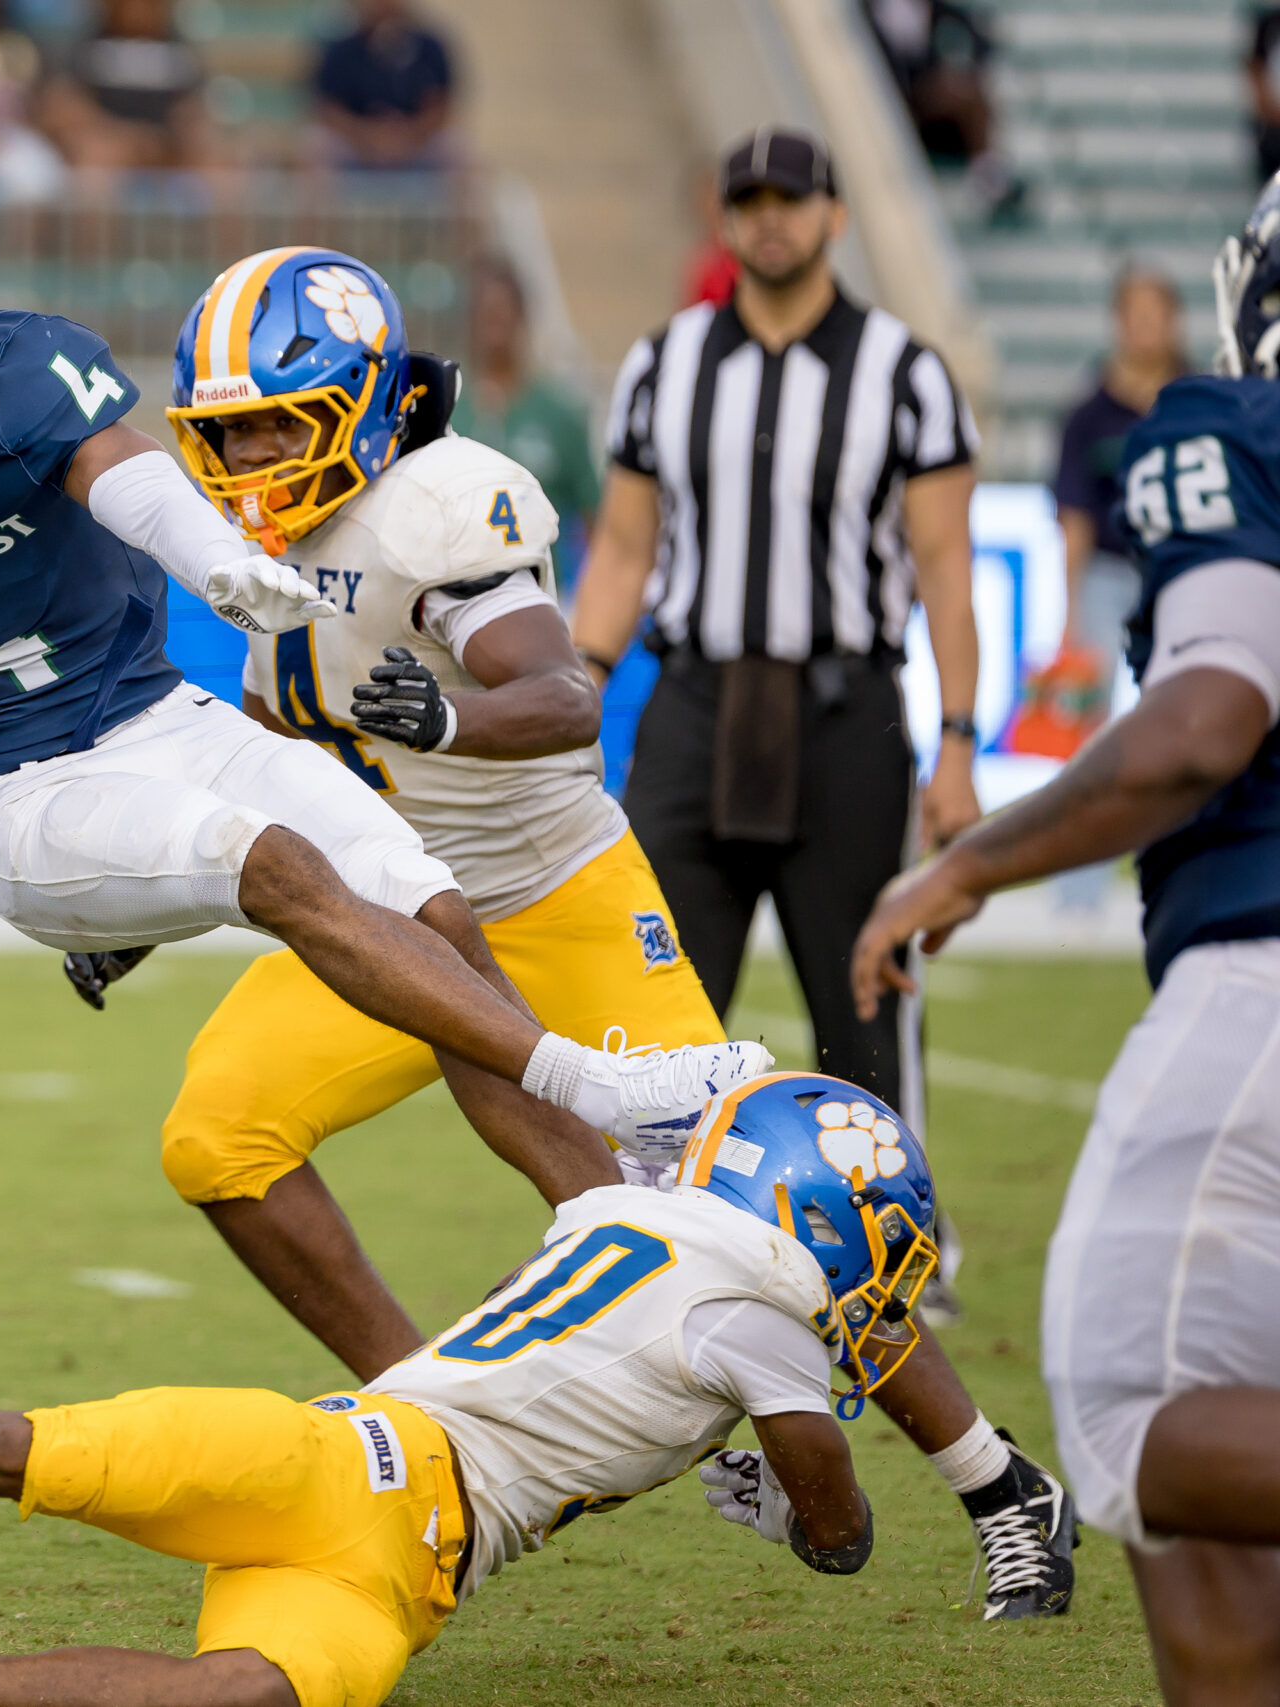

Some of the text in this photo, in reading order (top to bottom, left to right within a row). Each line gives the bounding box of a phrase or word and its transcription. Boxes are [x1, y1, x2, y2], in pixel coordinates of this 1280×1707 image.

[47, 350, 127, 426] 4
[195, 384, 249, 402] Riddell
[486, 489, 523, 546] 4
[1125, 433, 1239, 548] 62
[273, 620, 398, 796] 4
[361, 1418, 395, 1483] DUDLEY
